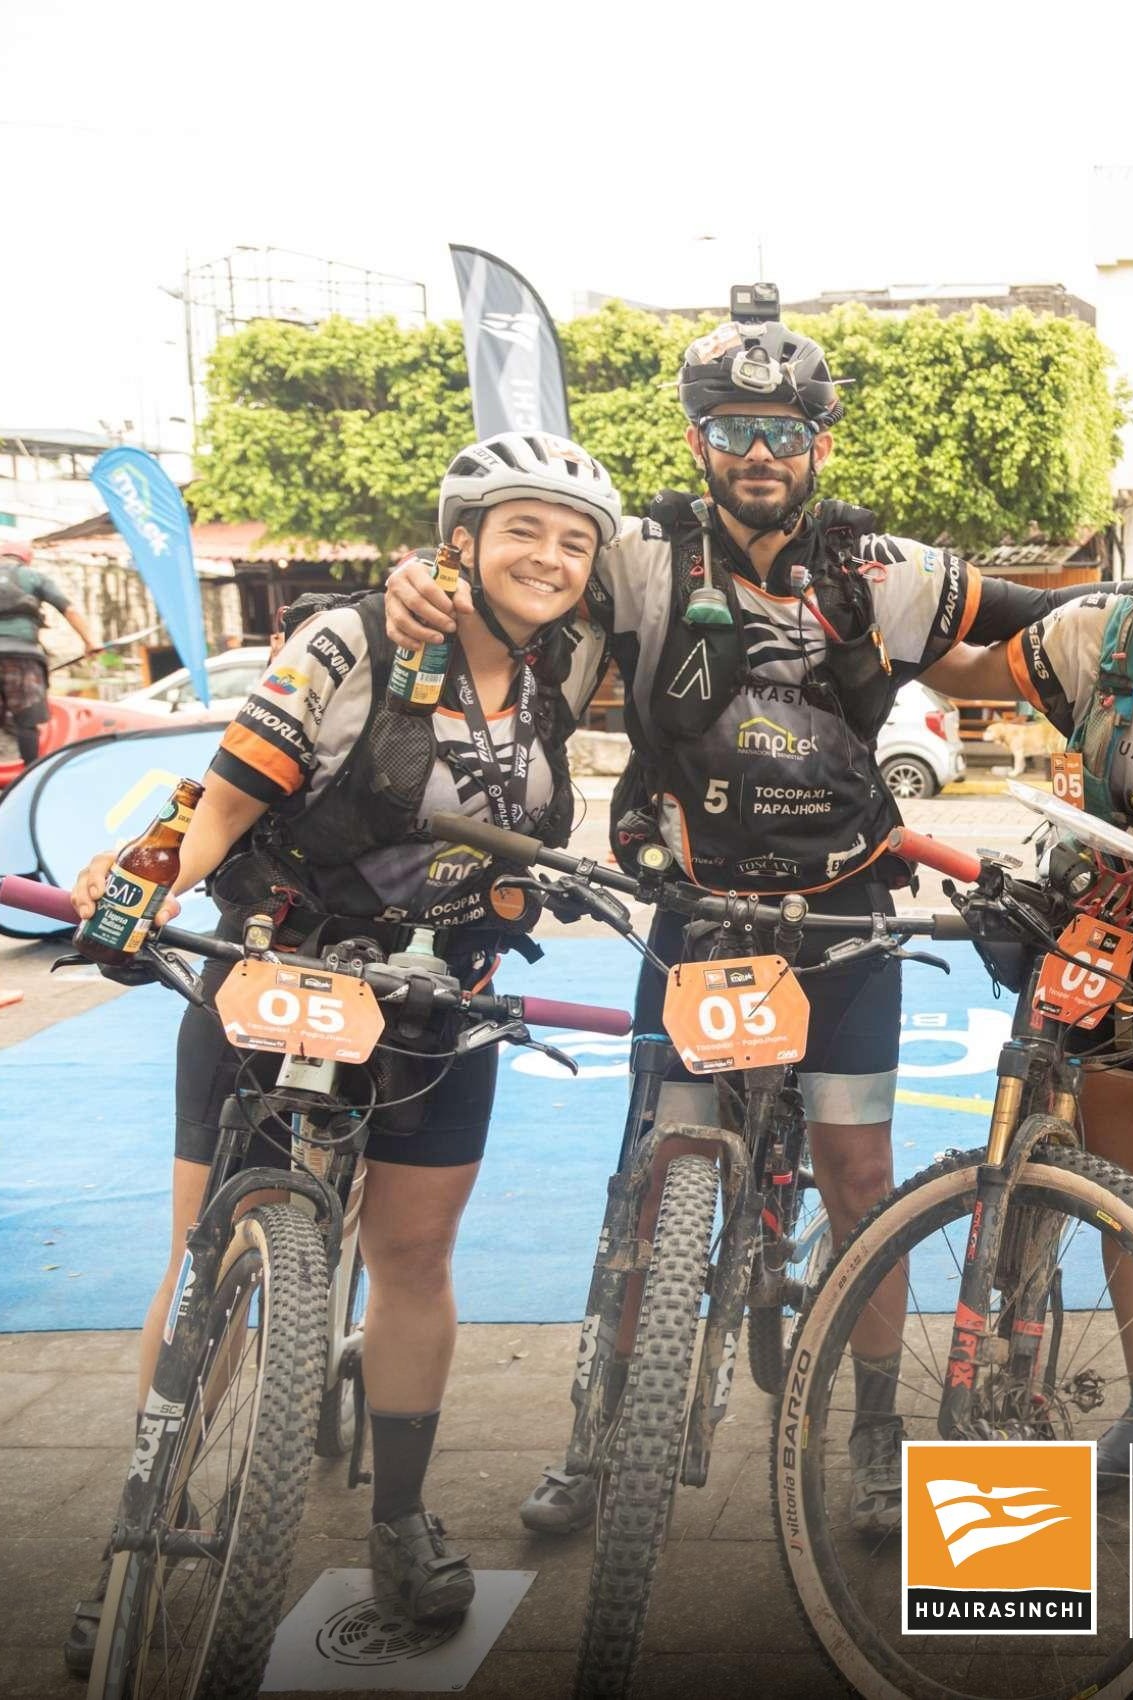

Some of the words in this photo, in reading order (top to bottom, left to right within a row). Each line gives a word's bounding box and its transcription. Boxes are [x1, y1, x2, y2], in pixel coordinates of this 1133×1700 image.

[704, 779, 730, 814] 5
[753, 802, 831, 816] PAPAJHONS
[755, 786, 825, 800] TOCOPAXI
[1053, 773, 1082, 798] 05
[1061, 951, 1113, 999] 05
[257, 988, 345, 1034] 05
[698, 991, 776, 1041] 05
[783, 1349, 811, 1471] BARZO
[127, 1417, 166, 1483] FOX
[784, 1475, 797, 1537] vittoria
